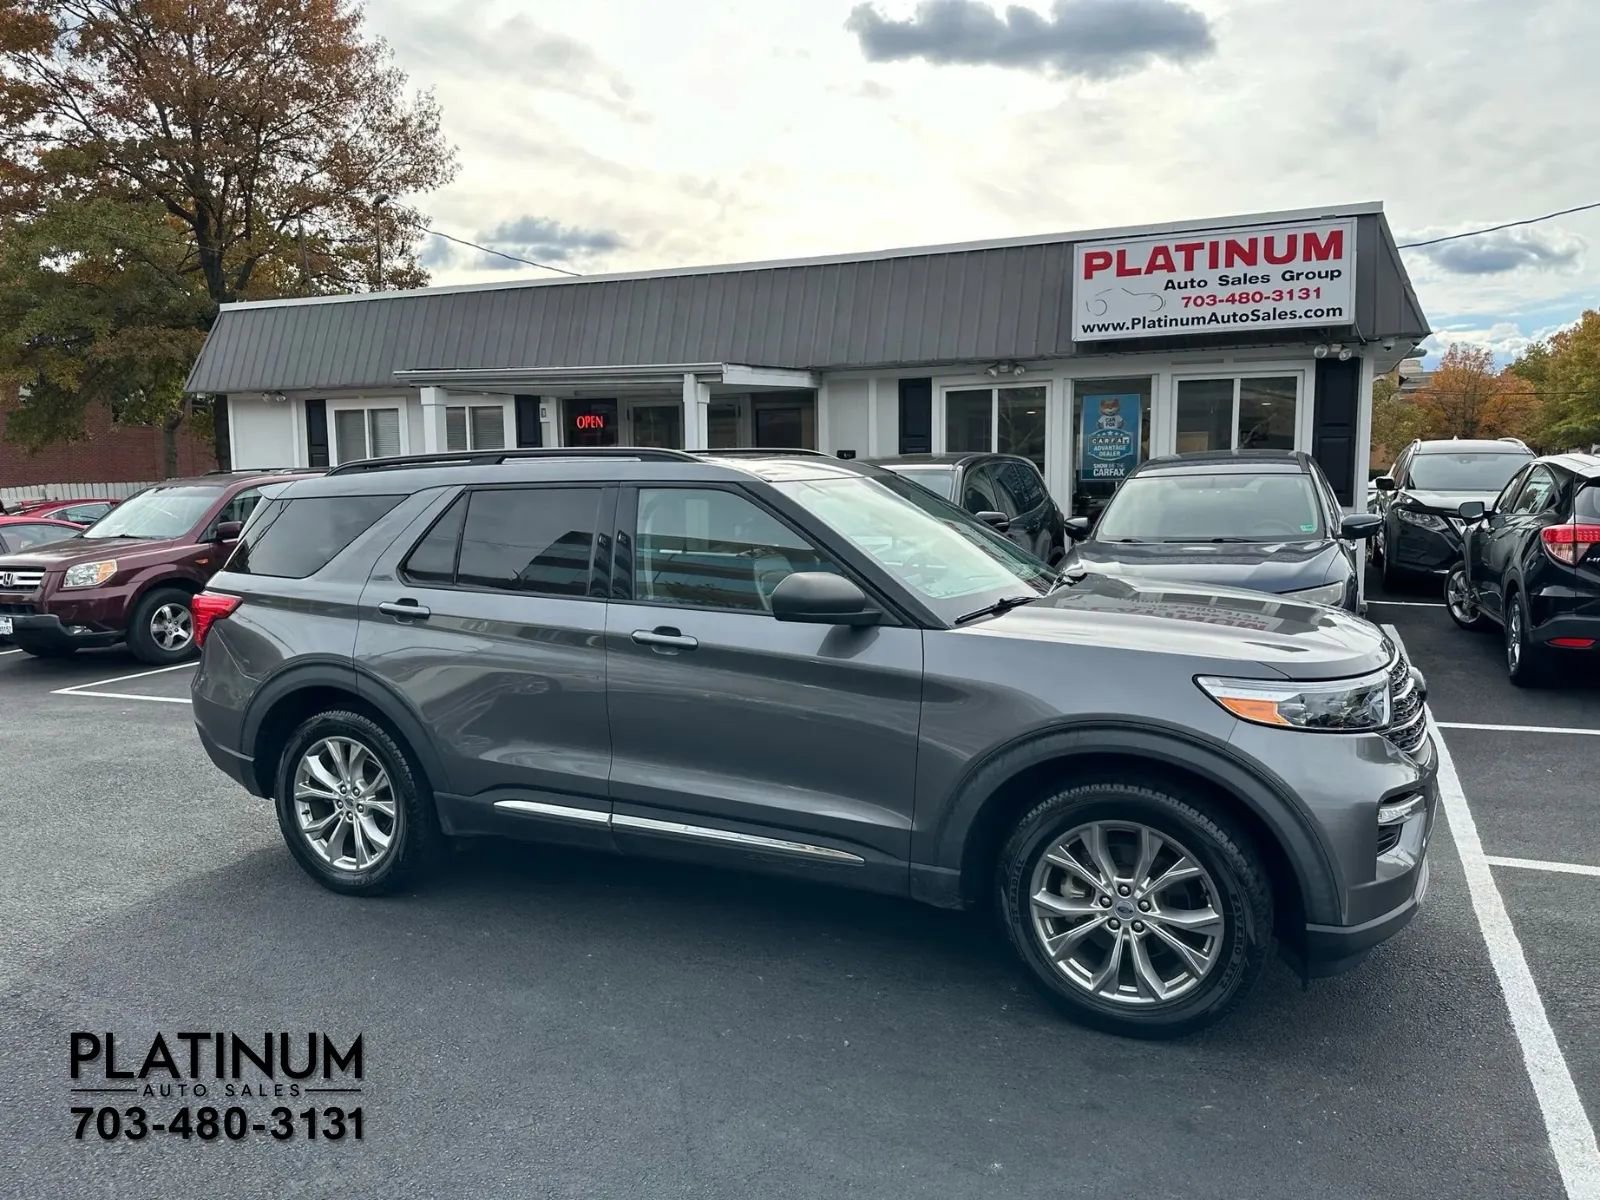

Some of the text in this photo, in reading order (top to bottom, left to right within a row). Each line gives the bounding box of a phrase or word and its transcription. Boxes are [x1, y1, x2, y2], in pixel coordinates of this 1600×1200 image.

[1084, 230, 1343, 280] PLATINUM
[1164, 268, 1342, 291] Auto Sales Group
[1181, 286, 1322, 308] 703-480-3131
[1081, 306, 1343, 333] www.PlatinumAutoSales.com
[576, 415, 604, 429] OPEN
[1093, 468, 1125, 476] CARFAX
